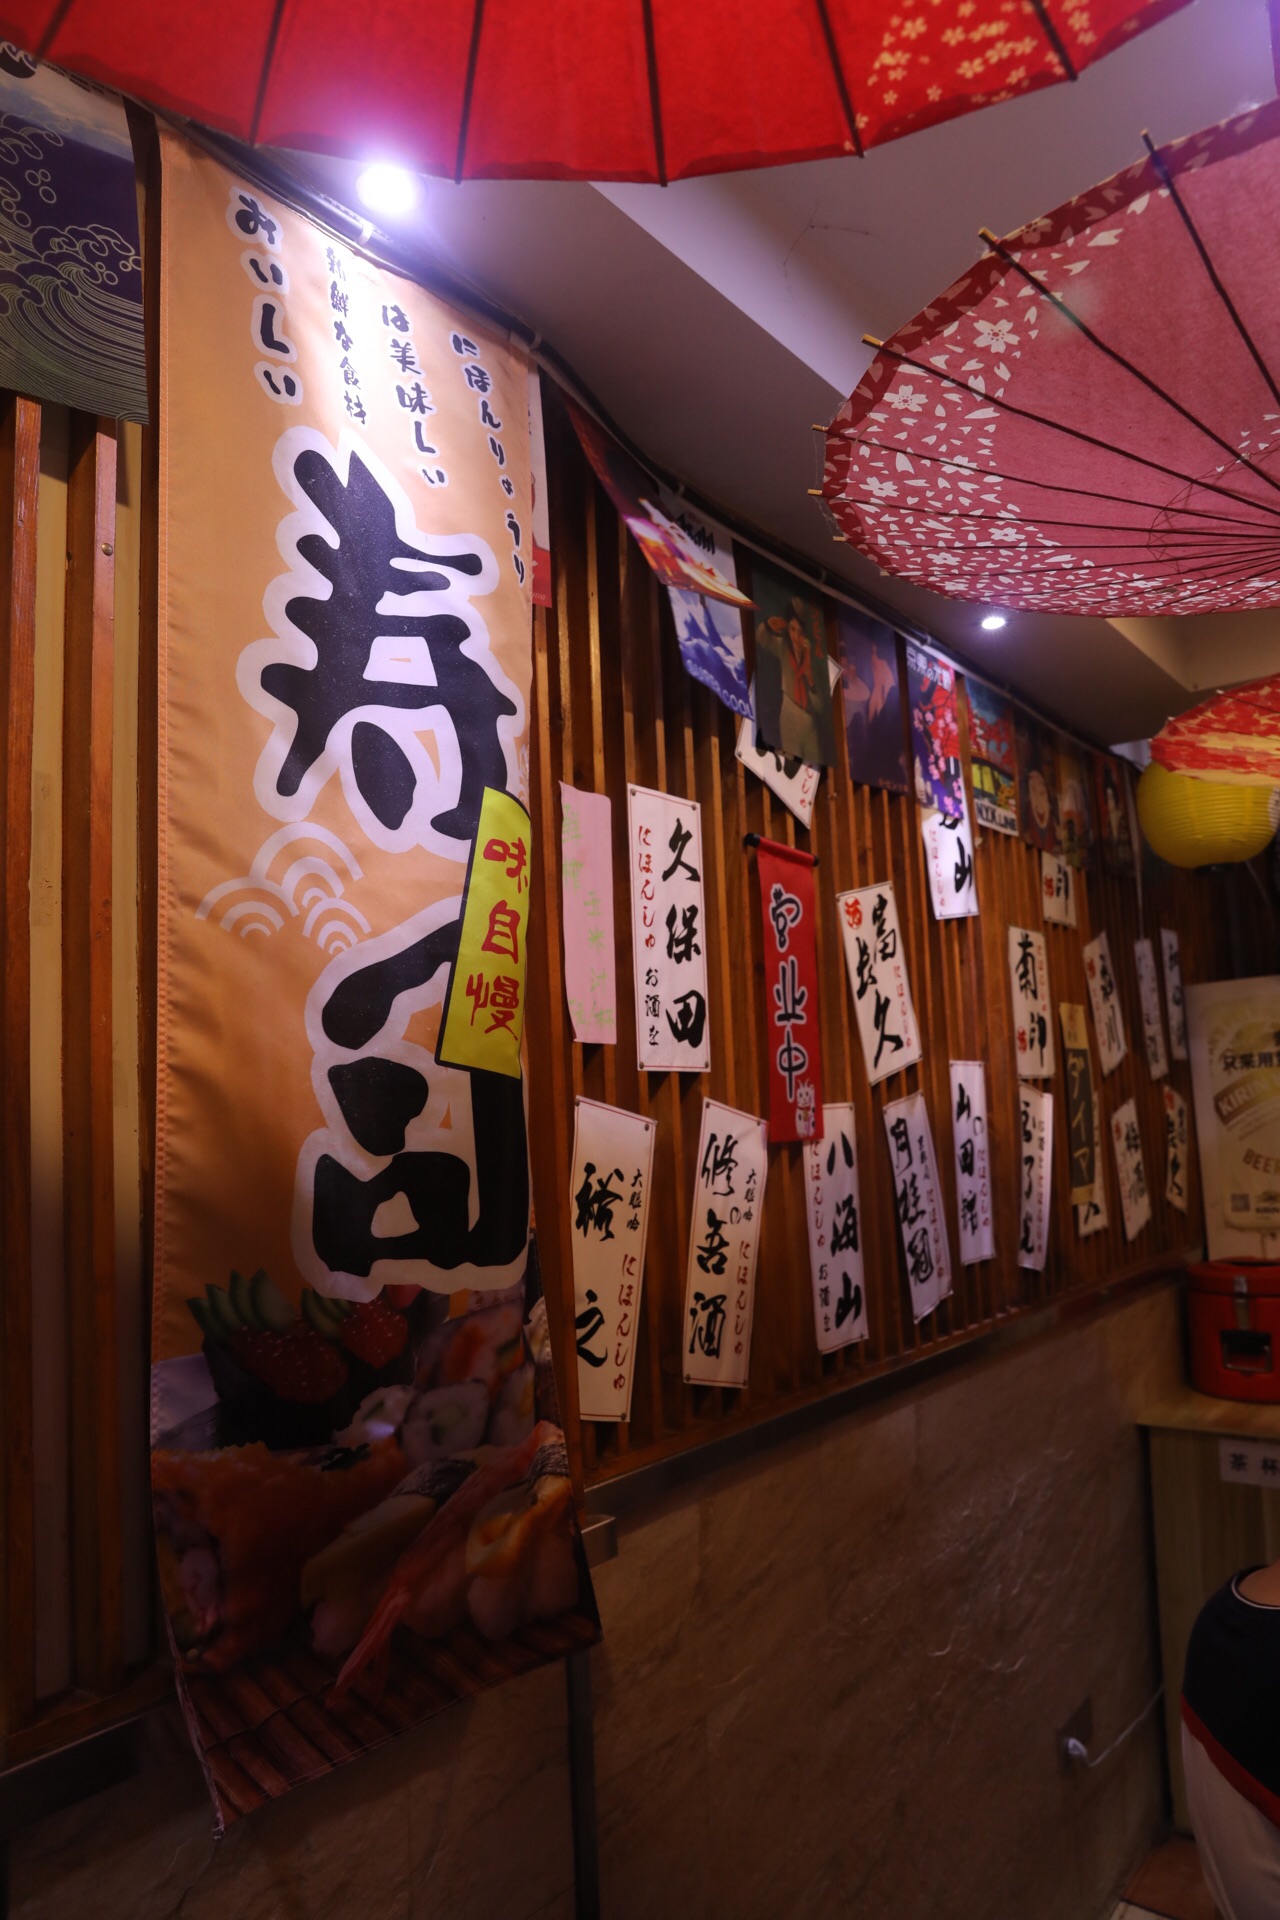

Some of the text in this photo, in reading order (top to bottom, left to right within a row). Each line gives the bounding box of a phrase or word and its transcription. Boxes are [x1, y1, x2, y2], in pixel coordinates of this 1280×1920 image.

[235, 194, 296, 397] おいしい
[382, 304, 446, 485] は美味しい
[453, 332, 526, 584] にほんりょうり
[465, 836, 528, 1041] 味自慢
[637, 825, 657, 949] にほんしゅ
[661, 817, 706, 1049] 久保田
[612, 1253, 637, 1391] にほんしゅ
[734, 1240, 751, 1355] にほんしゅ
[827, 1131, 861, 1330] 八海山
